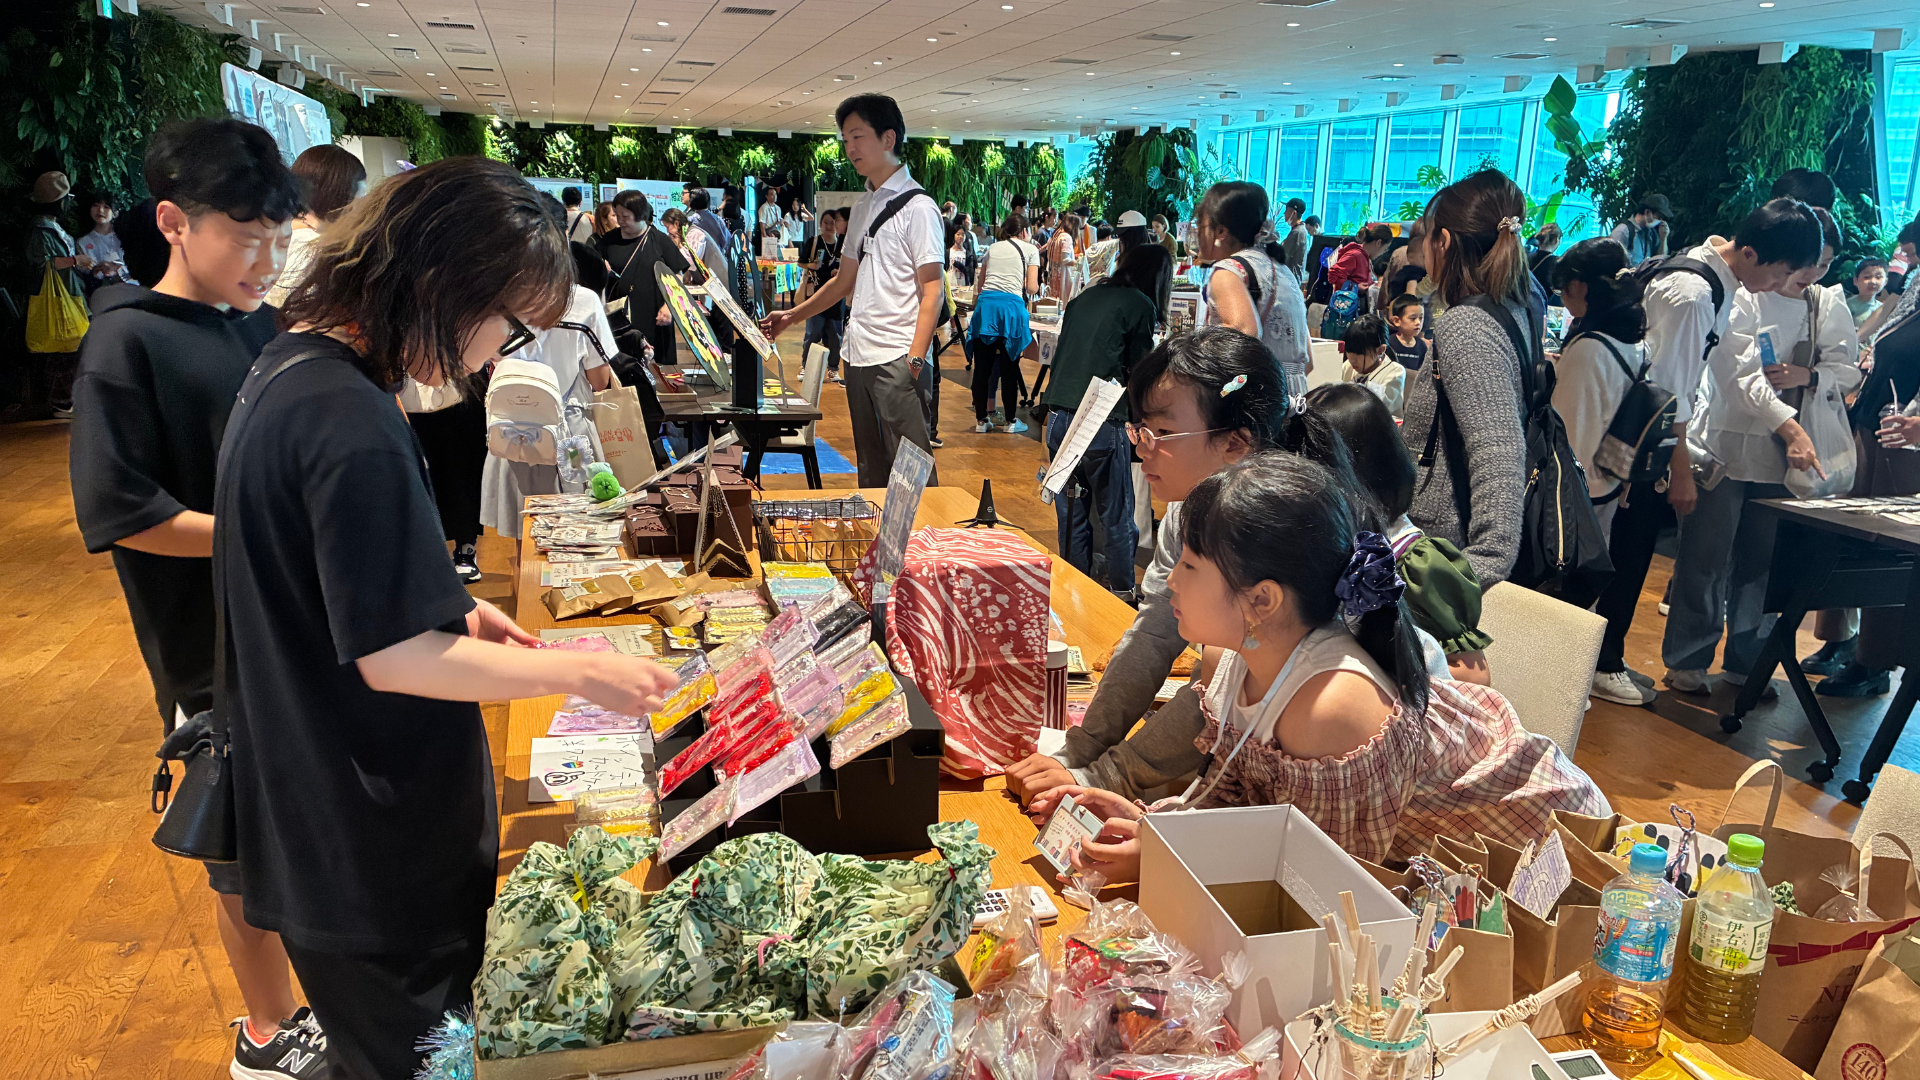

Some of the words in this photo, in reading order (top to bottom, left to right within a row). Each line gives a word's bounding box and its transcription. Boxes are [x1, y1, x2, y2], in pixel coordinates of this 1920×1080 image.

[1720, 921, 1743, 971] 伊右衛門
[276, 1047, 315, 1074] N
